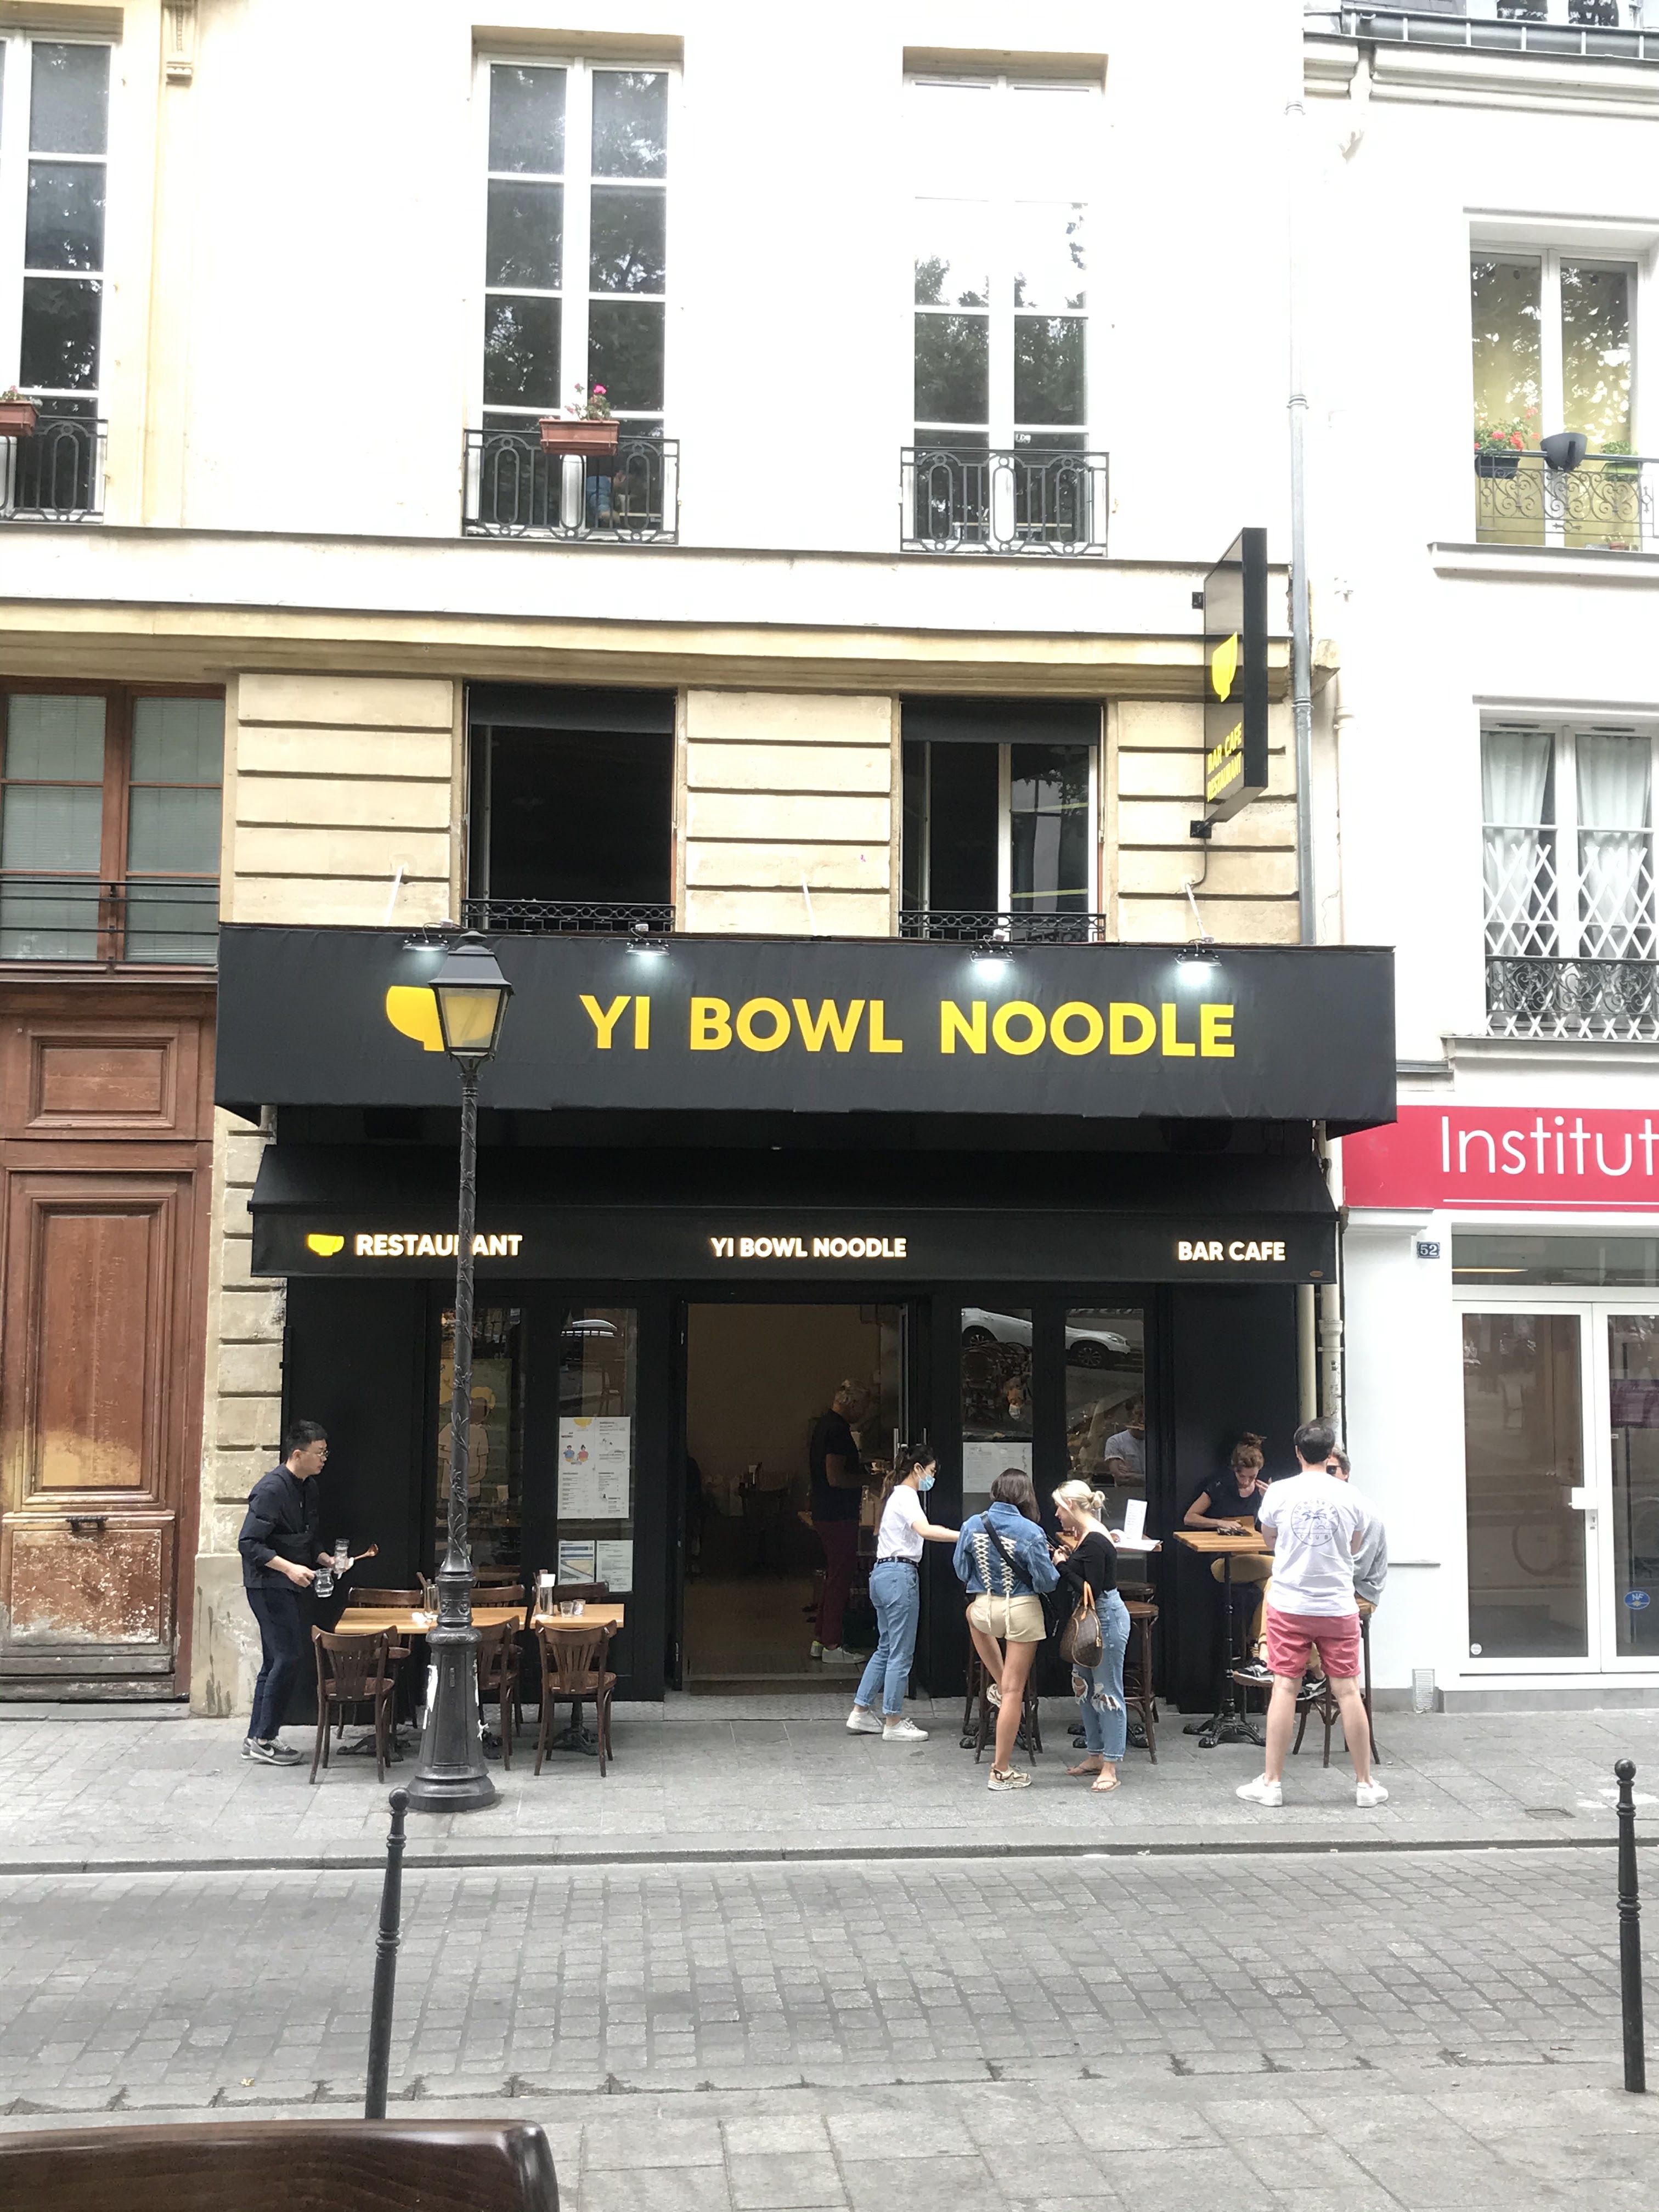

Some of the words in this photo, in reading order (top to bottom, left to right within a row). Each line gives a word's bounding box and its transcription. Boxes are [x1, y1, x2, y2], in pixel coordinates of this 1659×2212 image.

[1207, 744, 1222, 775] BAR
[1224, 722, 1242, 757] CAFE
[1207, 751, 1242, 802] RESTAURANT
[580, 995, 650, 1049] YI
[690, 997, 902, 1053] BOWL
[940, 1000, 1234, 1057] NOODLE
[1442, 1116, 1659, 1176] Institut
[710, 1237, 734, 1257] YI
[740, 1237, 808, 1257] BOWL
[814, 1237, 906, 1258] NOODLE
[1178, 1241, 1224, 1261] BAR
[1228, 1241, 1285, 1261] CAFE
[1420, 1244, 1437, 1256] 52
[1632, 1593, 1644, 1601] NF
